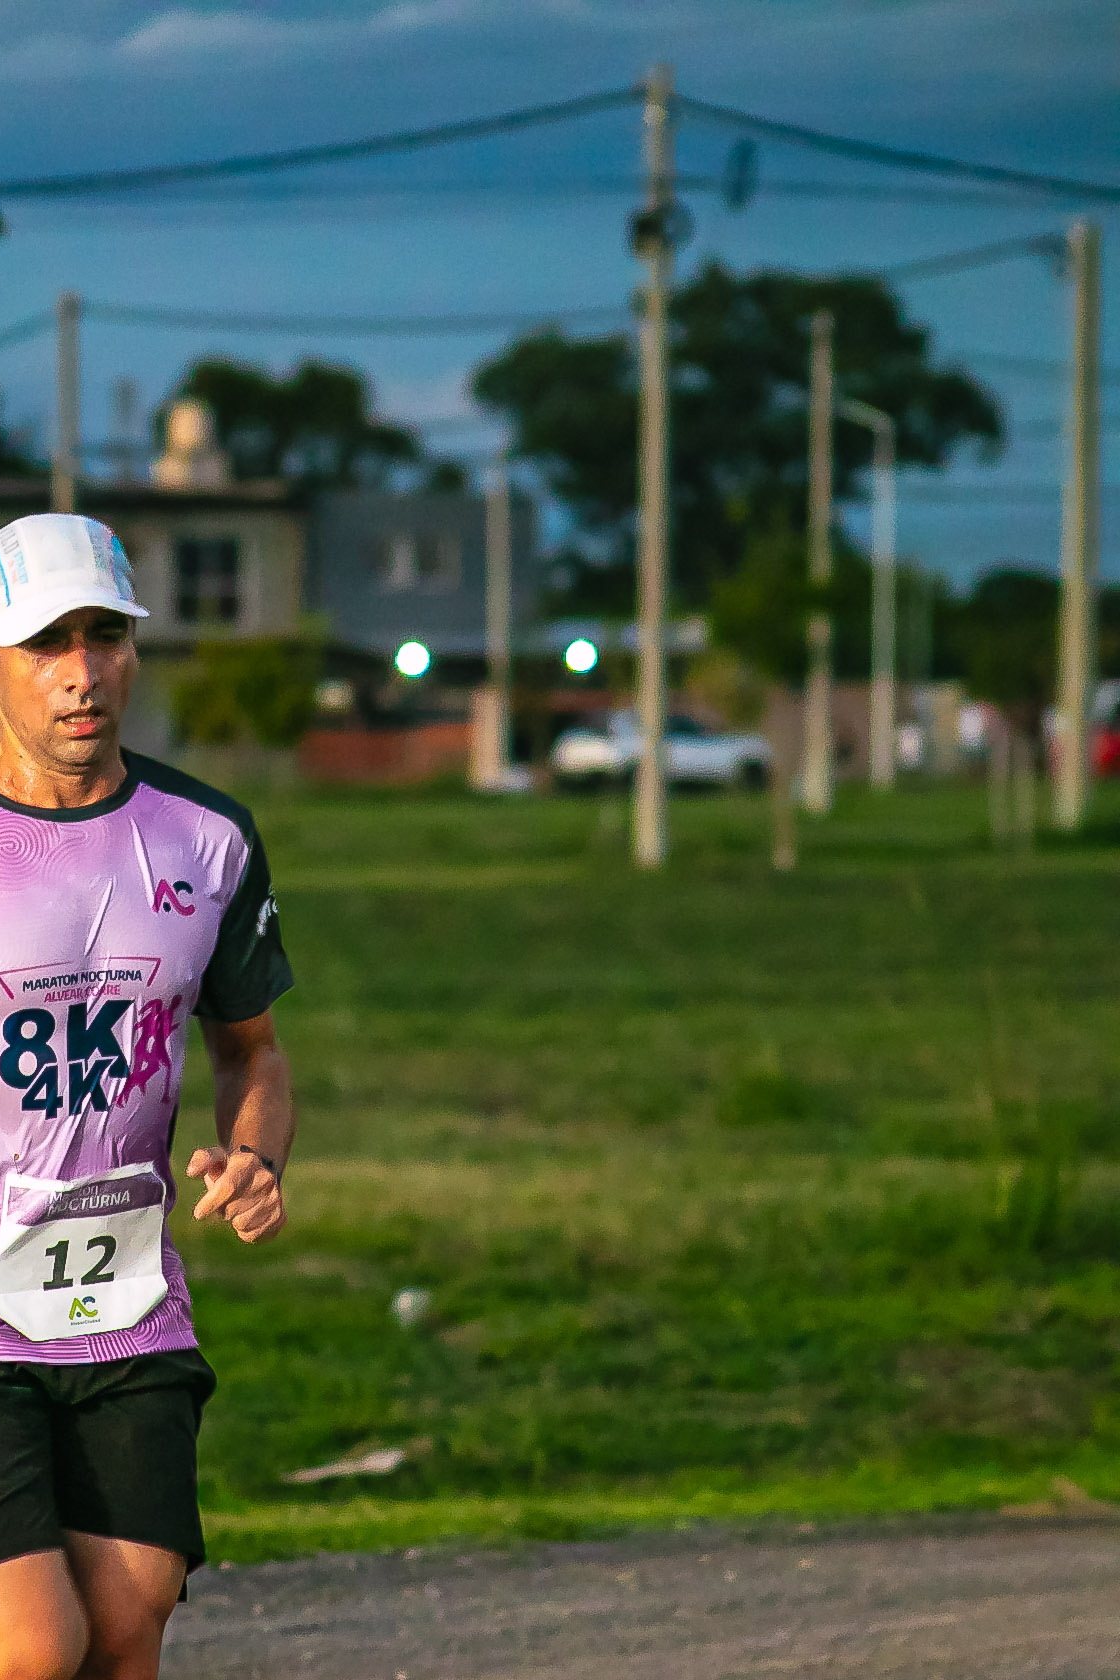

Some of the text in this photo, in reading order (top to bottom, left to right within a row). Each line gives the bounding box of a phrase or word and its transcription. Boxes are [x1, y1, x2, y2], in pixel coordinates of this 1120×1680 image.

[22, 969, 143, 992] MARATON NOCTURNA
[21, 1058, 111, 1120] 4K
[43, 1235, 118, 1291] 12
